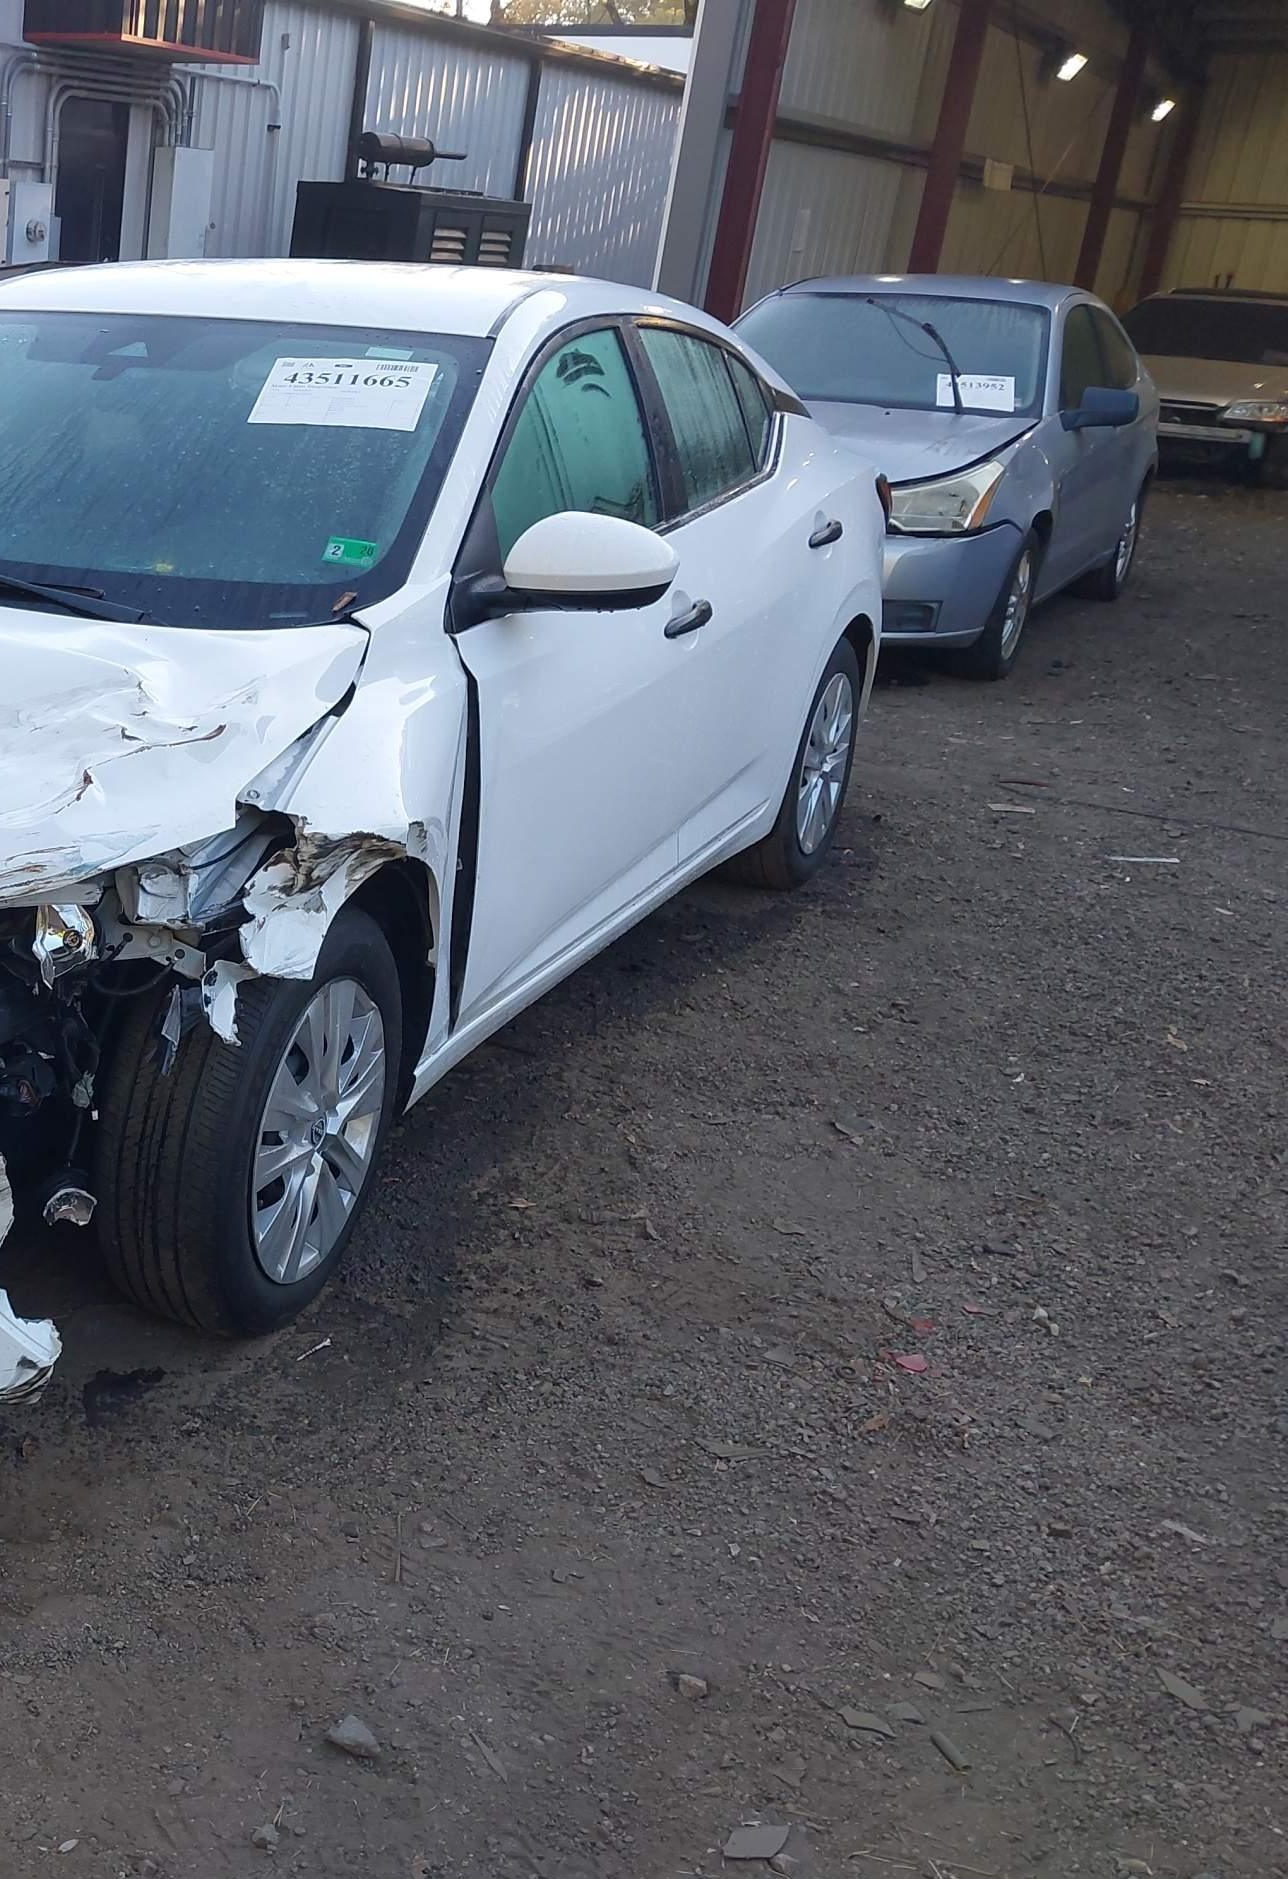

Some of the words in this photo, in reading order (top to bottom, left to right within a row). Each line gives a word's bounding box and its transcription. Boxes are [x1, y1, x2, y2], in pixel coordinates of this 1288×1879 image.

[283, 372, 413, 389] 43511665
[946, 382, 1006, 391] 4513952
[332, 545, 342, 556] 2
